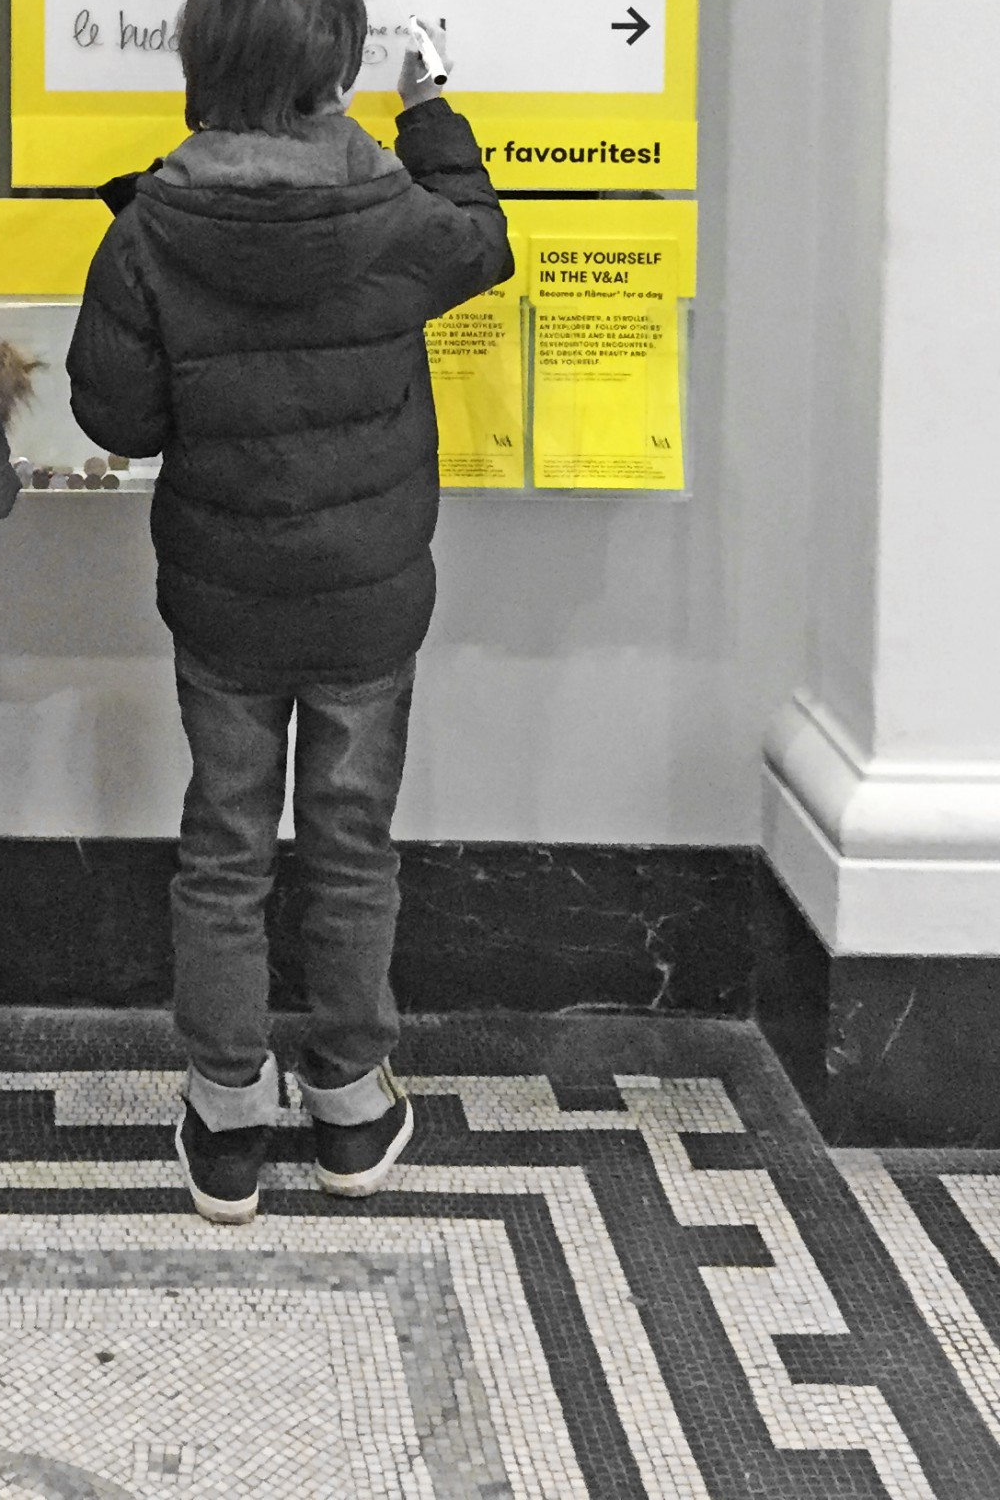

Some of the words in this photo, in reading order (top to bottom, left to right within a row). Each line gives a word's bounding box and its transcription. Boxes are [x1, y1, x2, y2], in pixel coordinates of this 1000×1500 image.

[504, 140, 660, 164] favourites!
[540, 251, 578, 264] LOSE
[583, 252, 662, 265] YOURSELF
[540, 271, 555, 282] IN
[560, 271, 587, 283] THE
[592, 271, 628, 283] V&A!
